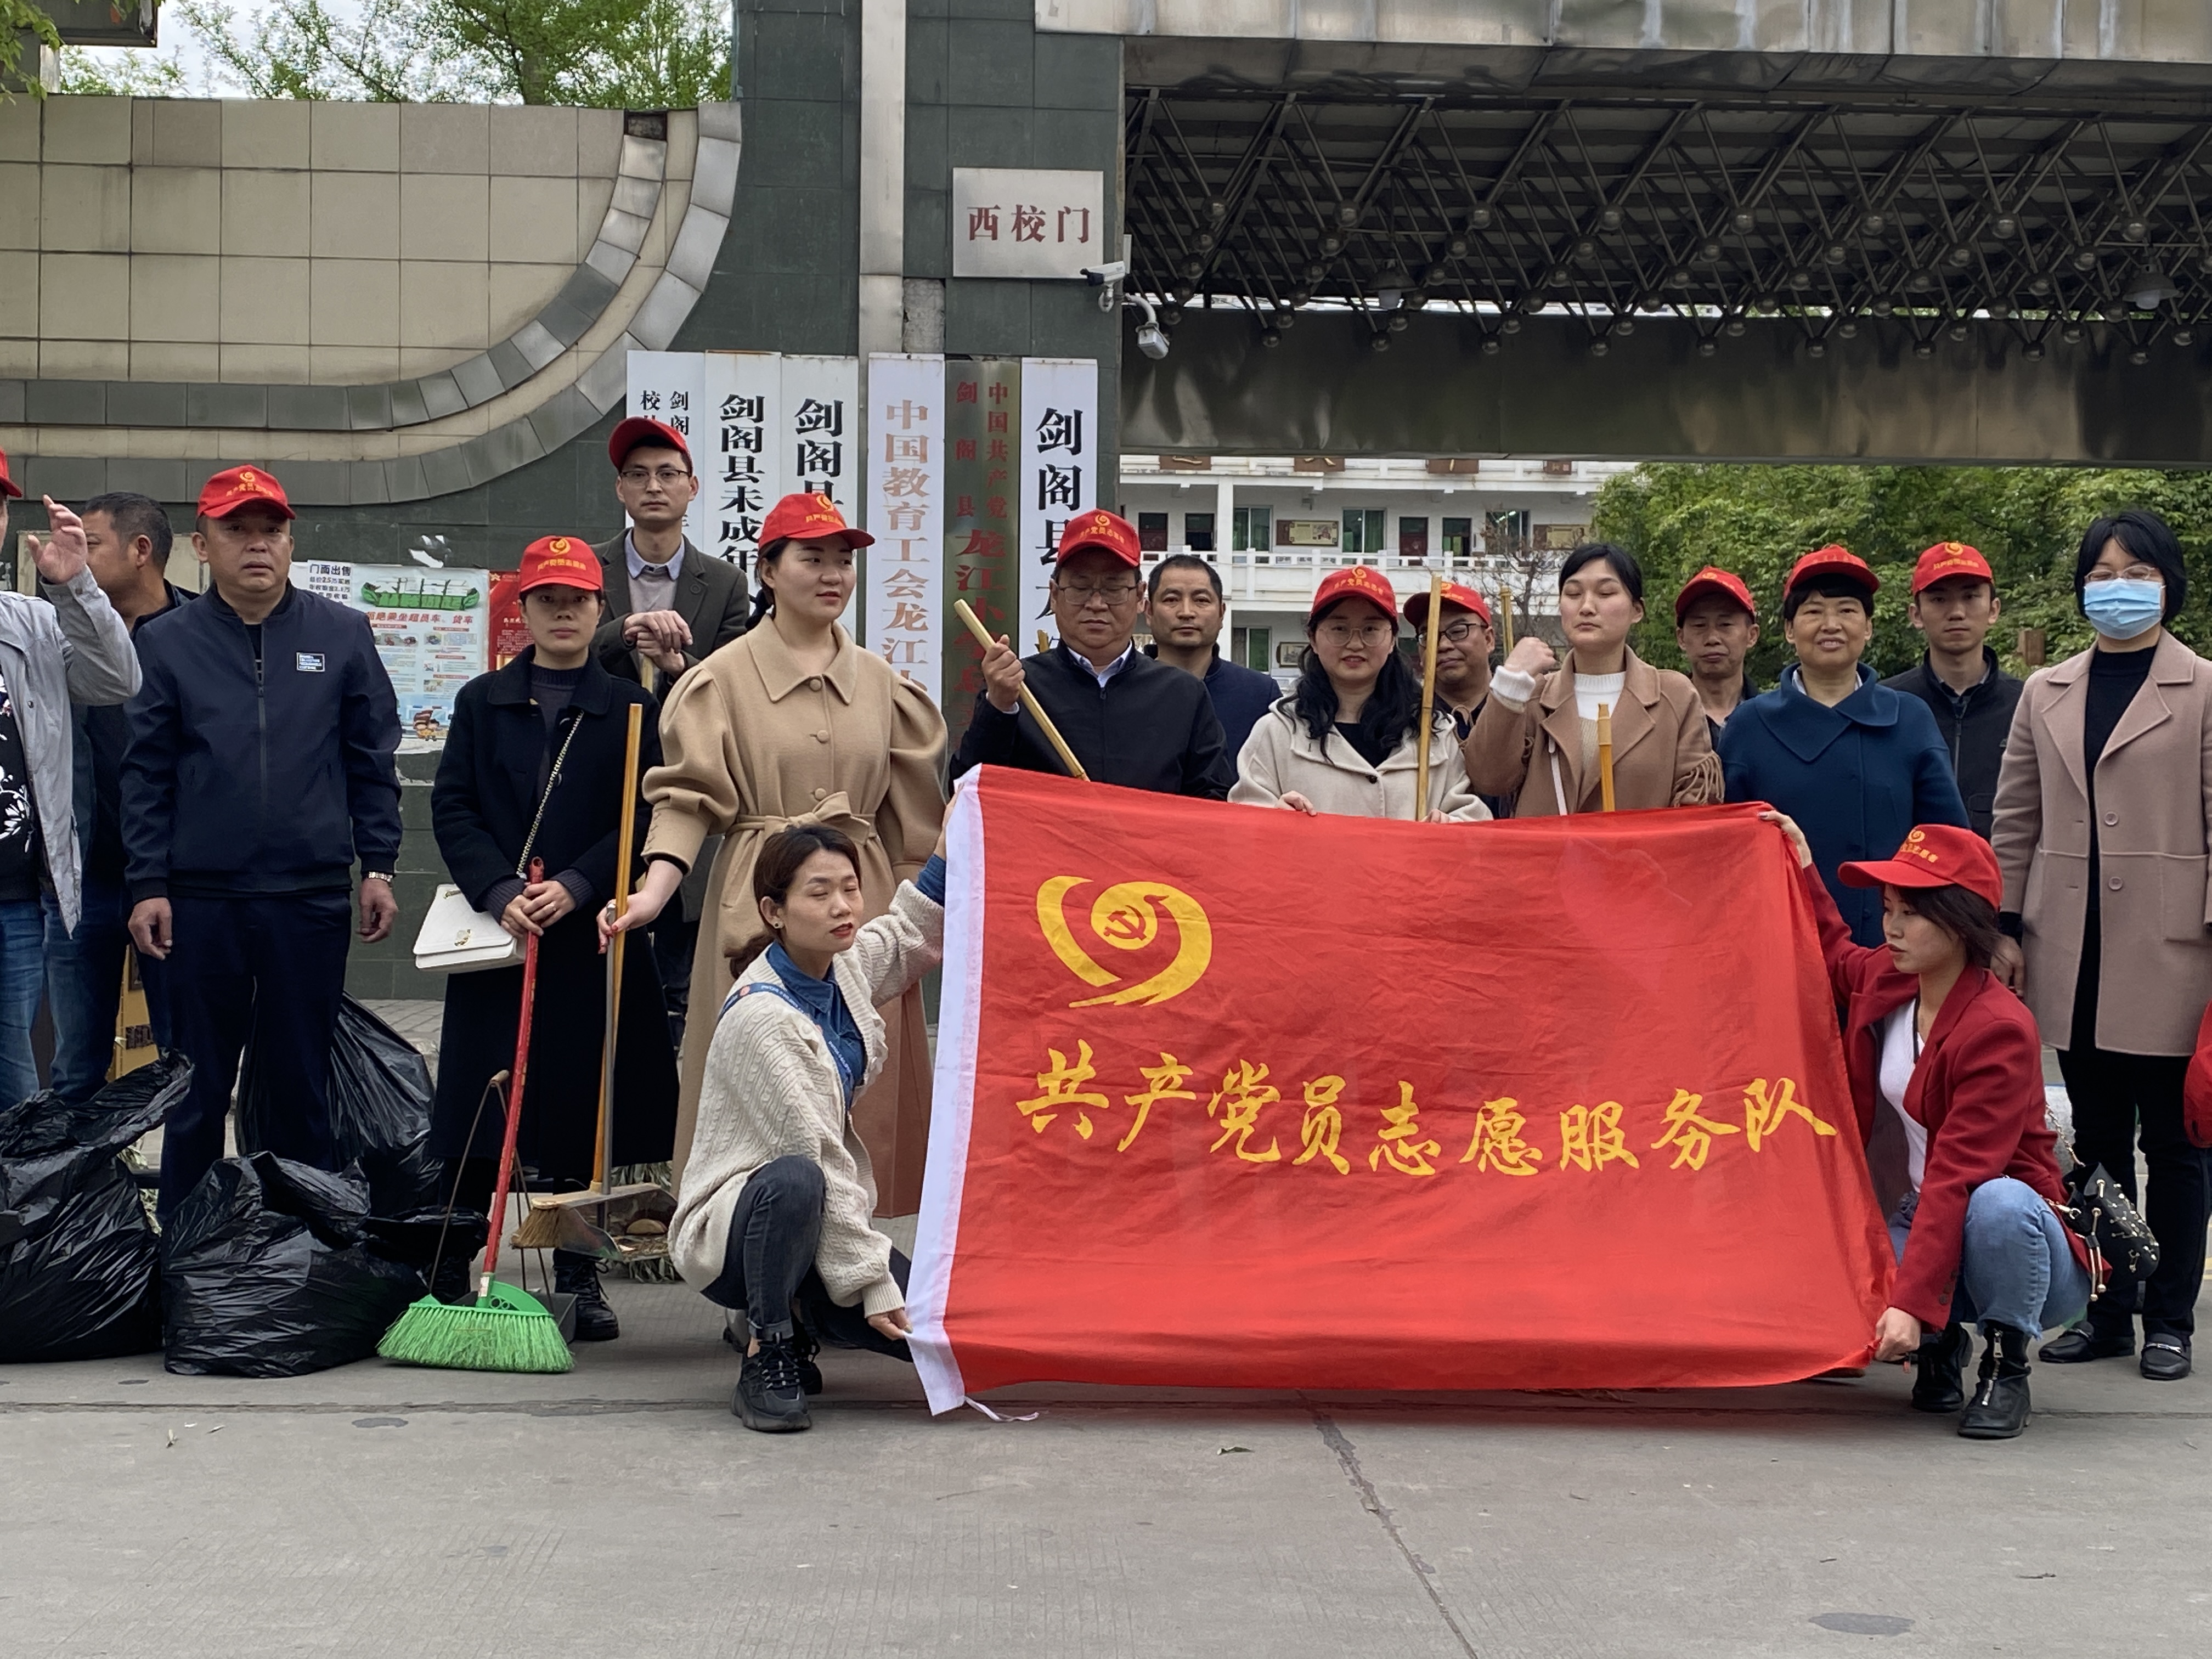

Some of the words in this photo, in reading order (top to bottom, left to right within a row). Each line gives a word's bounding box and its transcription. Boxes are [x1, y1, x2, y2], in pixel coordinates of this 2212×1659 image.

[967, 204, 1090, 243] 西校门
[718, 393, 766, 574] 剑阁县未成年
[955, 381, 978, 518] 剑阁县
[988, 381, 1009, 520] 中国共产党
[309, 563, 351, 577] 门面出售
[1015, 1038, 1837, 1177] 共产党员志愿服务队
